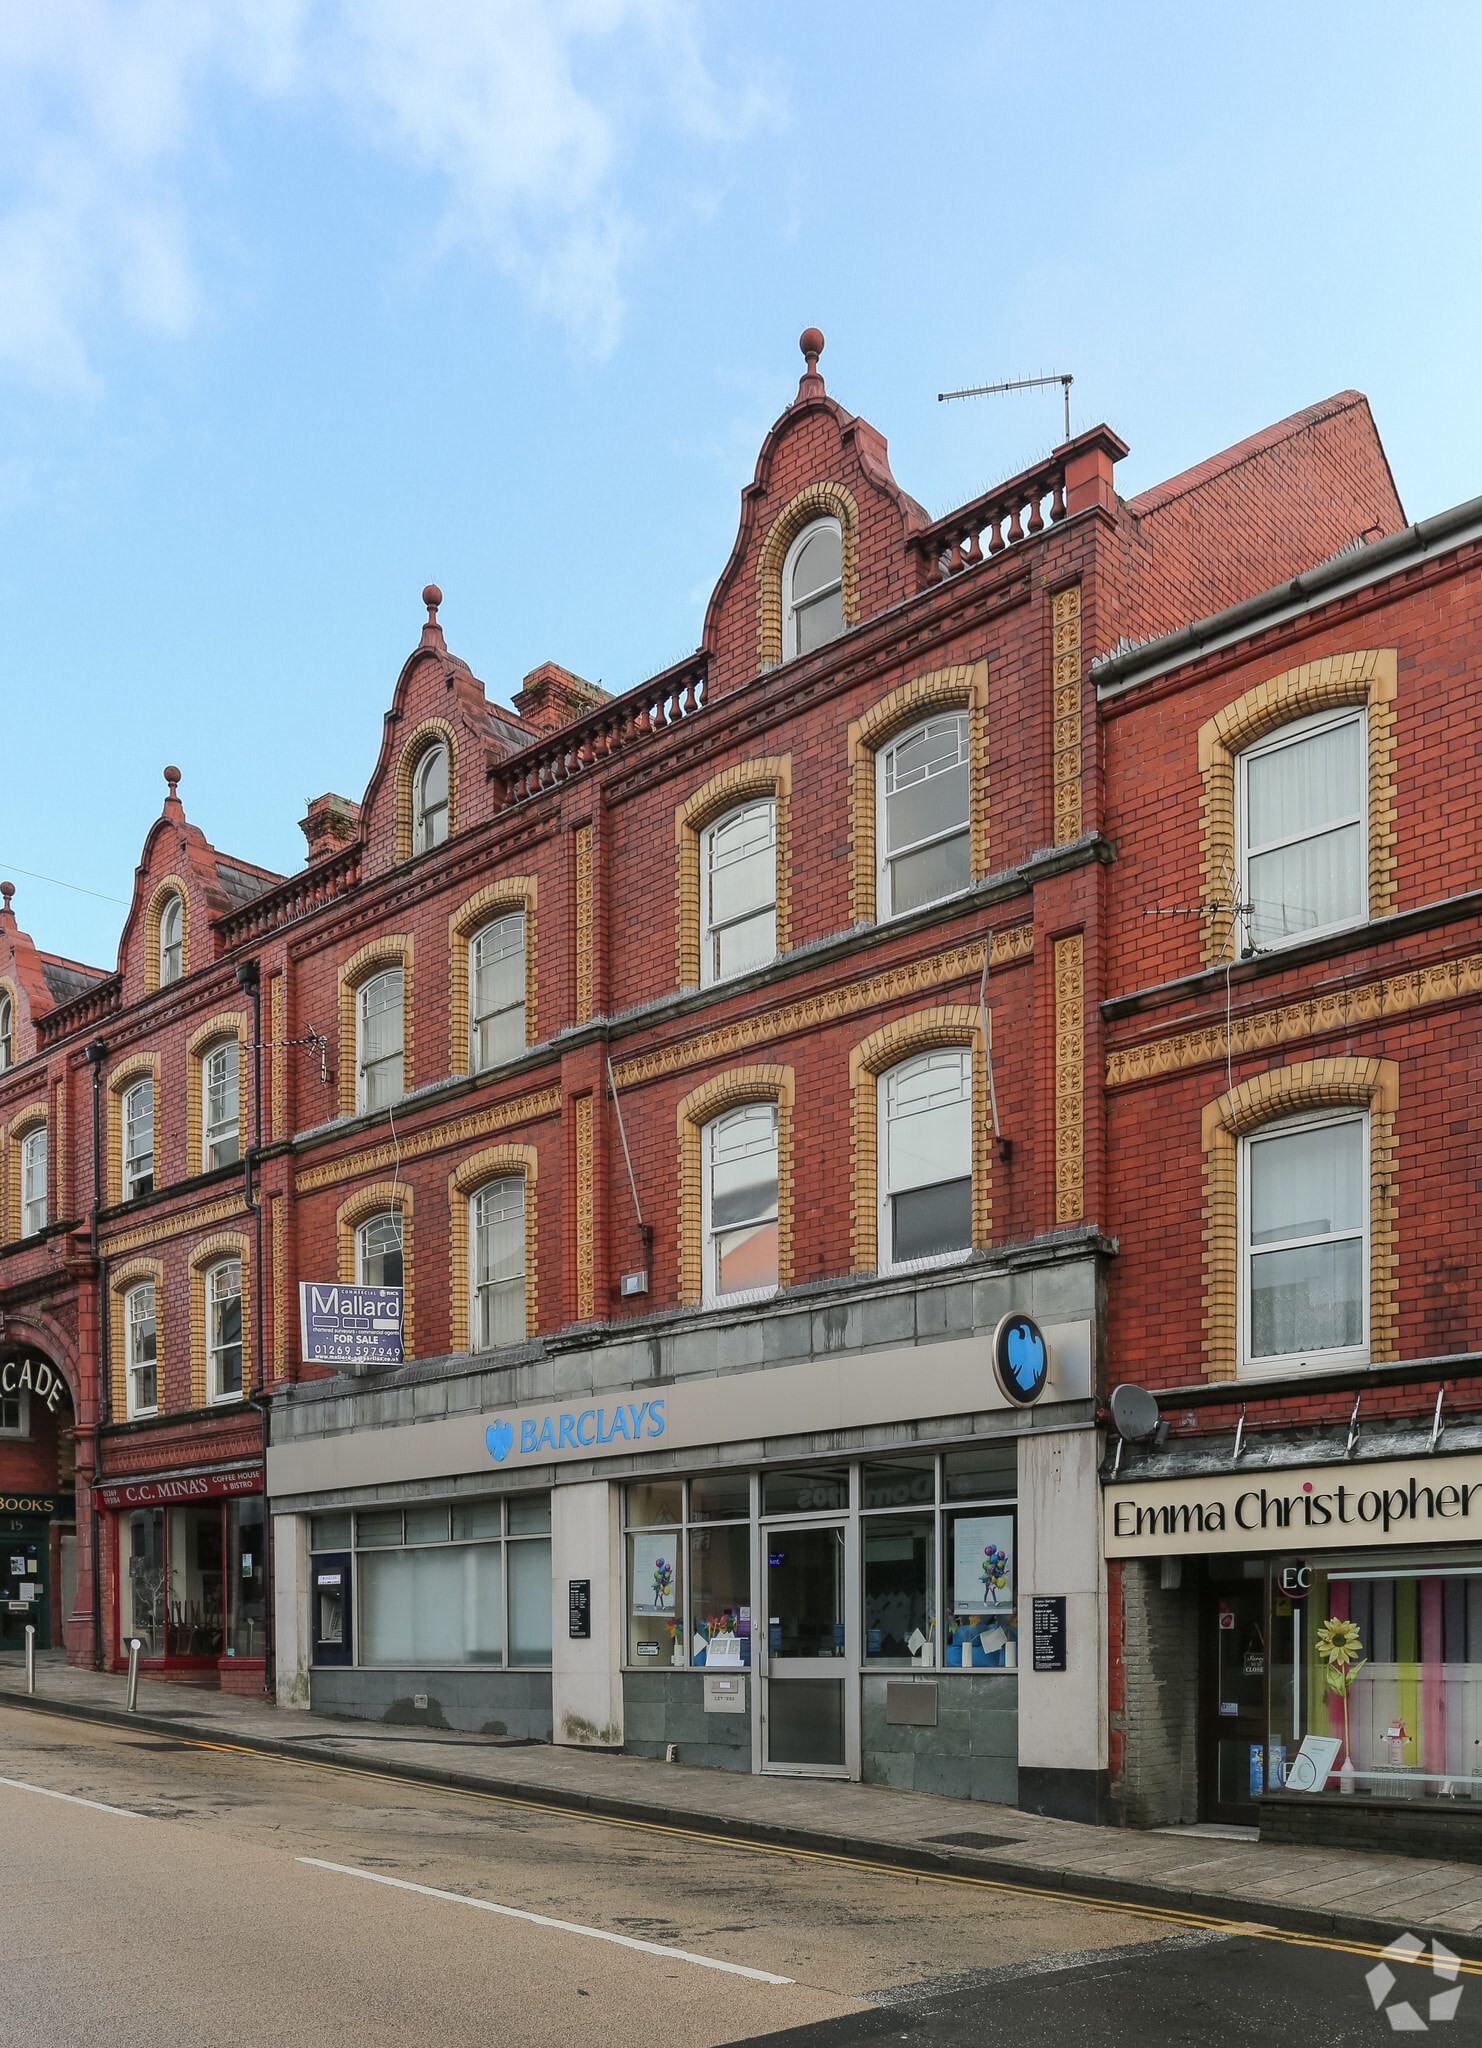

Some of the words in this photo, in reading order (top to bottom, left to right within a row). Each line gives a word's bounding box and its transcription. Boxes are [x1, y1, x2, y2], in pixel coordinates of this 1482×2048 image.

[311, 1286, 400, 1317] Mallard
[314, 1344, 351, 1355] 01269
[355, 1346, 400, 1357] 597949
[333, 1334, 353, 1344] FOR
[355, 1335, 379, 1345] SALE
[0, 1359, 64, 1413] CADE
[520, 1400, 665, 1454] BARCLAYS
[212, 1474, 236, 1483] COFFEE
[237, 1470, 260, 1479] HOUSE
[230, 1481, 253, 1490] BISTRO
[125, 1485, 155, 1502] C.C.
[156, 1478, 209, 1498] MINA'S
[1114, 1501, 1226, 1537] Emma
[1234, 1478, 1482, 1533] Christopher
[11, 1519, 24, 1531] 15
[1283, 1567, 1313, 1589] EC
